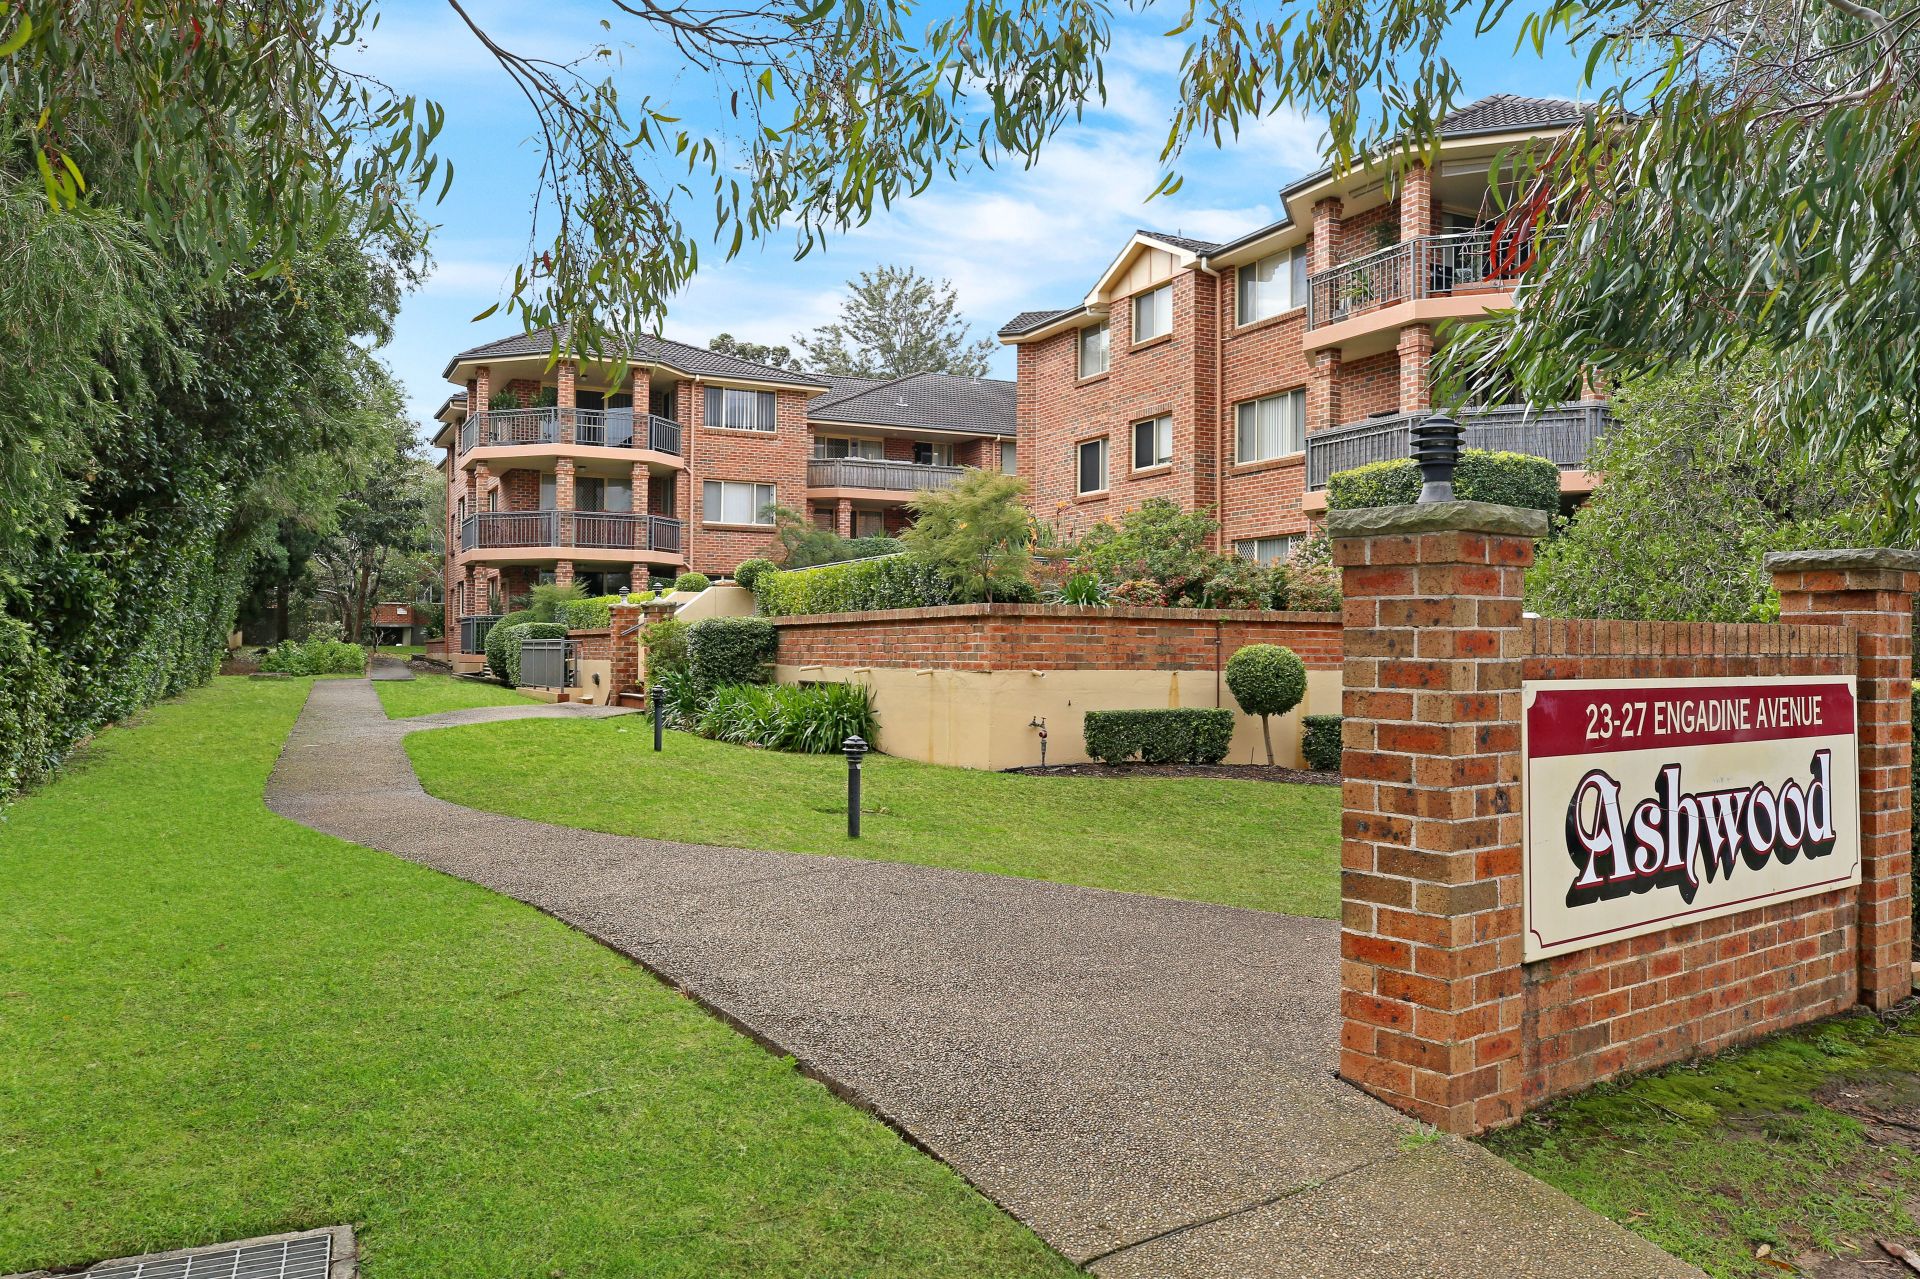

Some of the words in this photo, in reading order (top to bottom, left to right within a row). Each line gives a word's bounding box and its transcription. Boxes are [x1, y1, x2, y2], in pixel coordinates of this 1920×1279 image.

[1585, 702, 1647, 740] 23-27
[1654, 699, 1751, 735] ENGADINE
[1756, 696, 1823, 728] AVENUE
[1566, 749, 1836, 906] Ashwood
